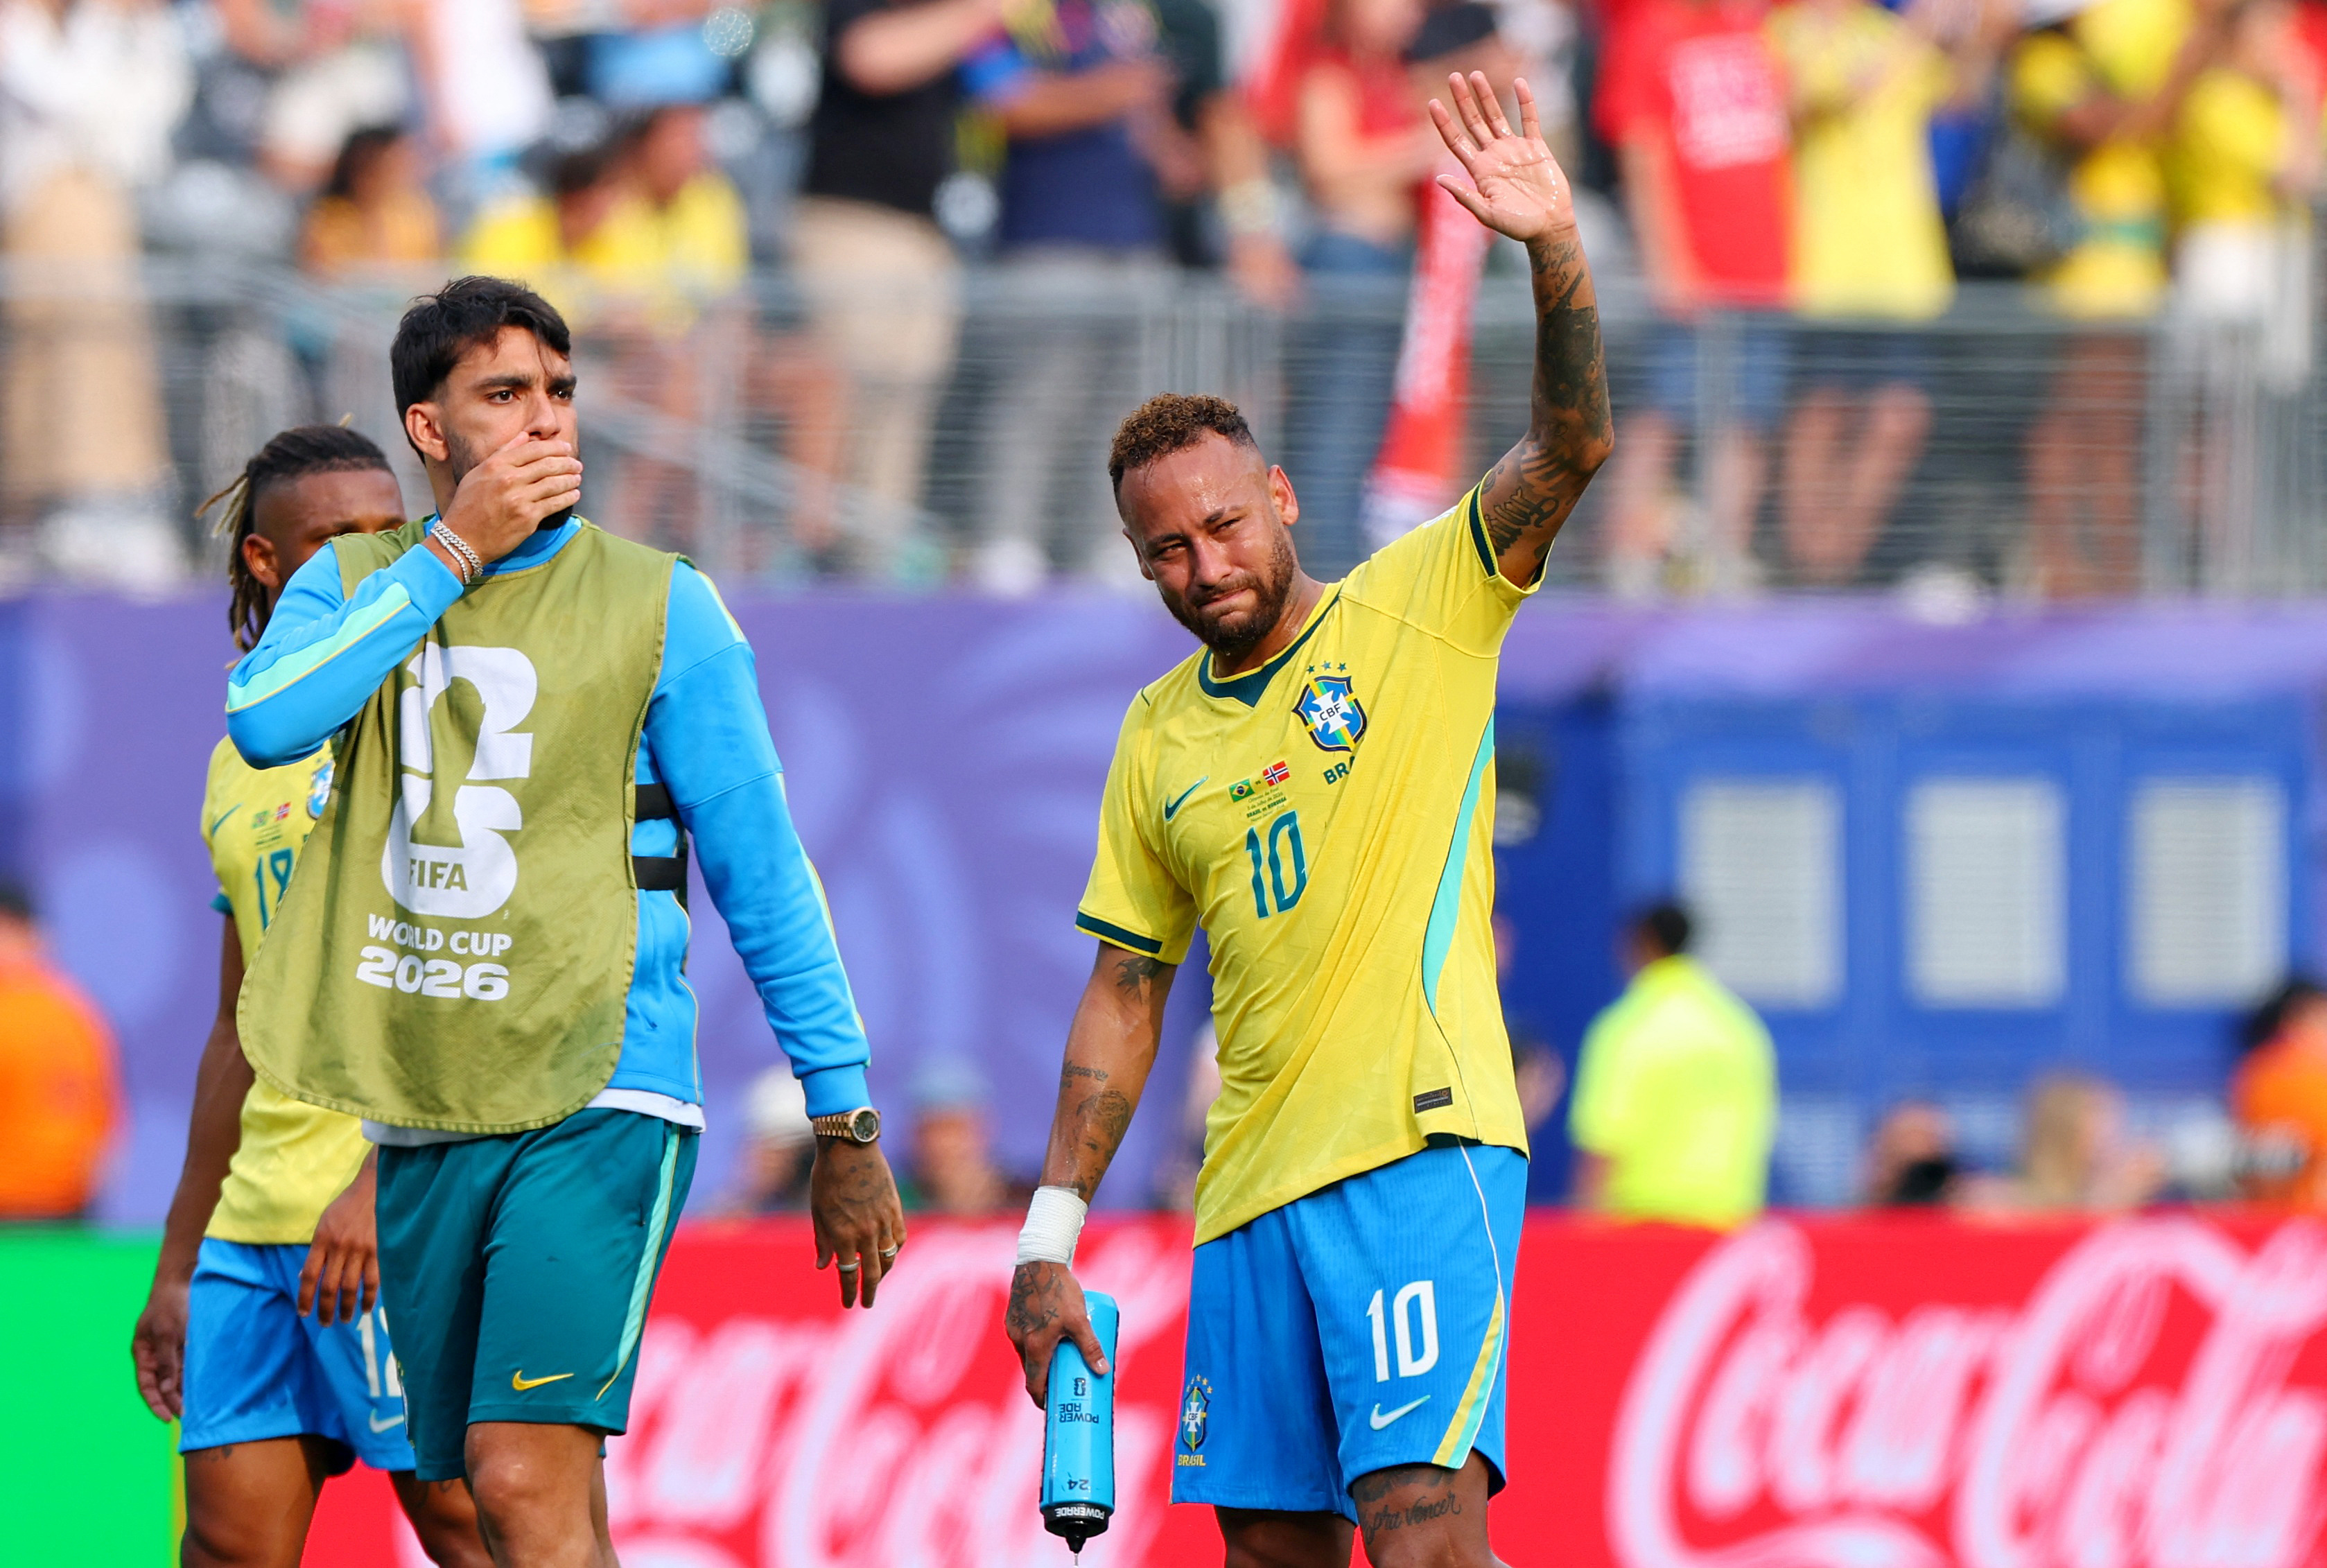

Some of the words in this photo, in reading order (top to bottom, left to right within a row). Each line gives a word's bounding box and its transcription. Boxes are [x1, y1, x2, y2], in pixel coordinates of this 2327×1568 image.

[1319, 703, 1342, 721] CBF
[1244, 809, 1308, 920] 10
[368, 913, 444, 952] WORLD
[449, 931, 512, 957] CUP
[356, 945, 509, 1001] 2026
[1366, 1280, 1440, 1383] 10
[1058, 1403, 1081, 1413] ADE
[1059, 1413, 1099, 1424] POWER
[1178, 1454, 1206, 1467] BRASIL
[1067, 1479, 1089, 1490] 24
[1054, 1506, 1105, 1519] POWERADE
